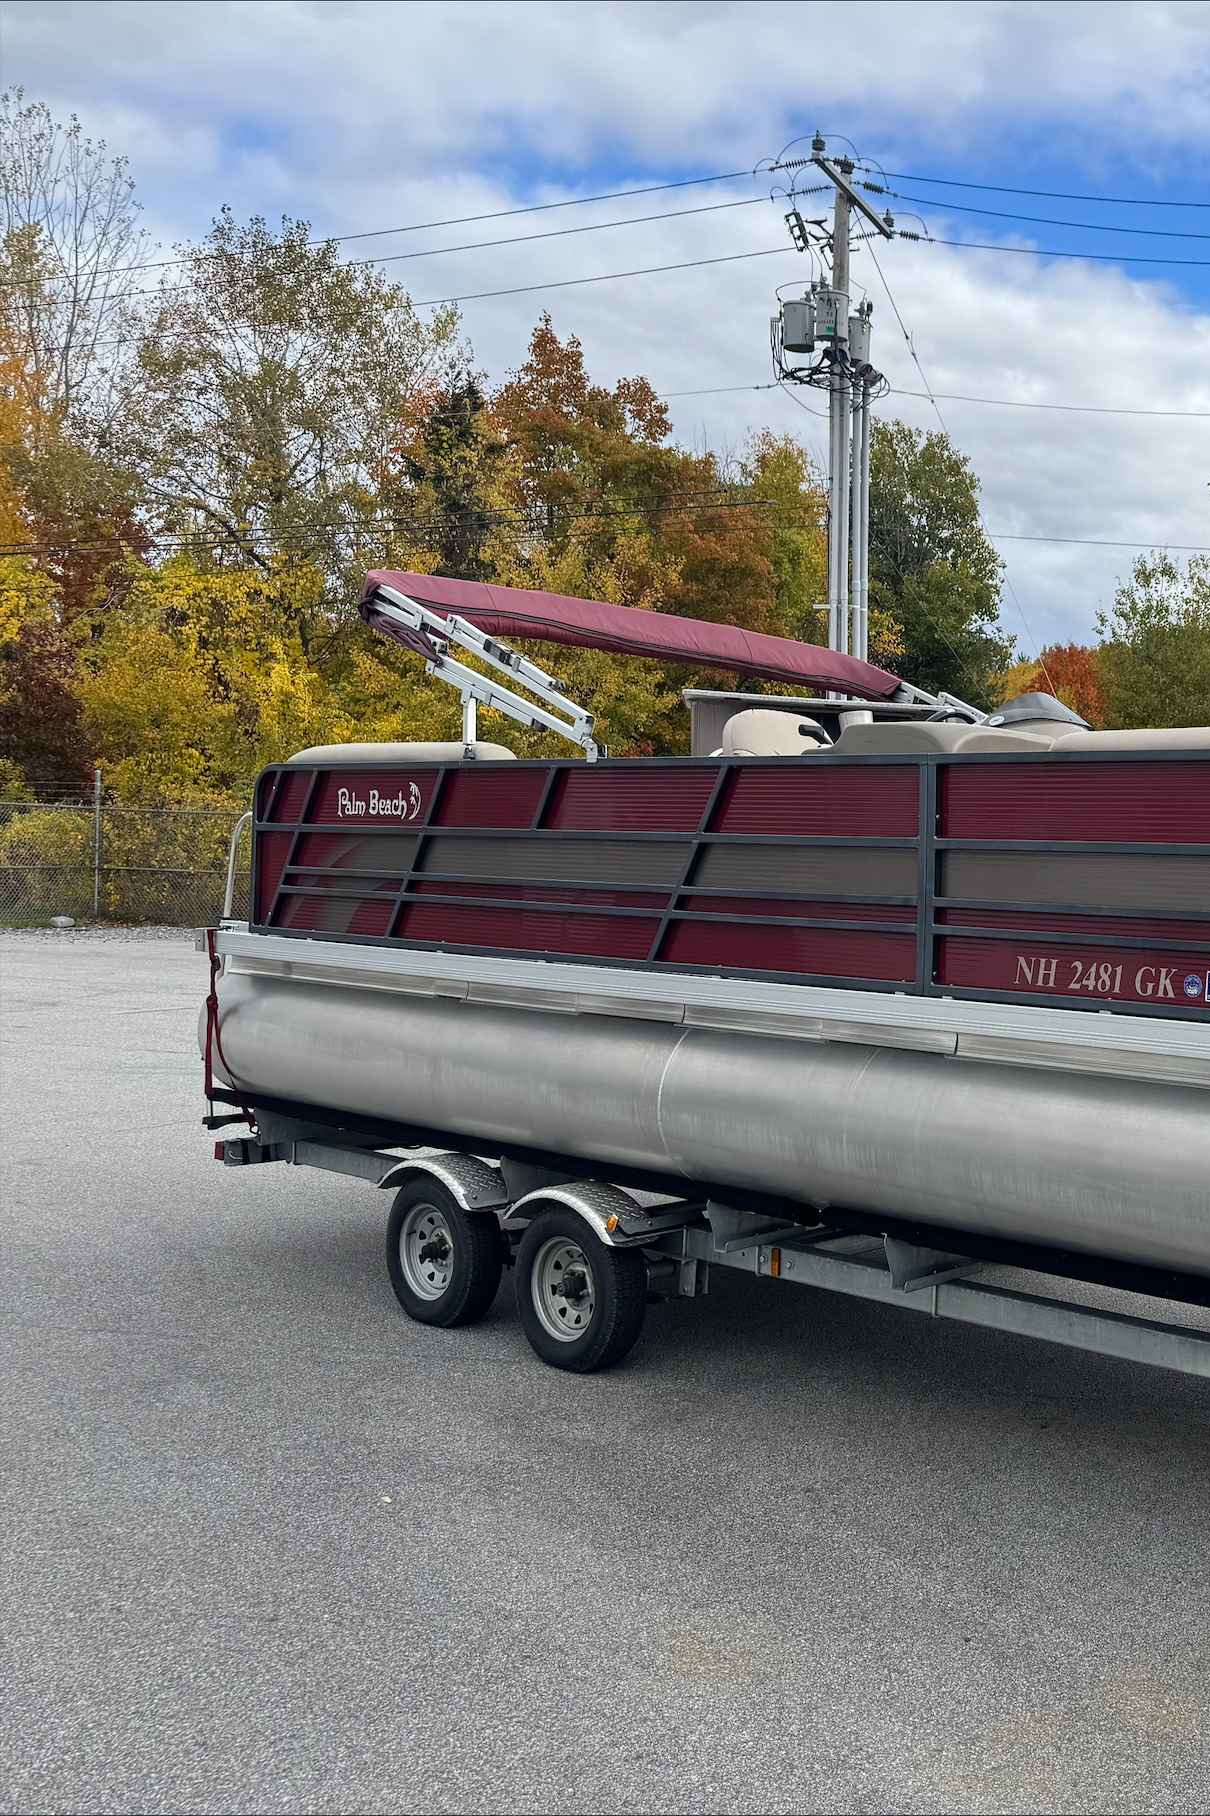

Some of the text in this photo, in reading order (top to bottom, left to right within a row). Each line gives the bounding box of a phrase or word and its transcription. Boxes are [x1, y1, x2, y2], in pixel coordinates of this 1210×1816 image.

[337, 787, 408, 819] Palm Beach
[1013, 956, 1178, 998] NH 2481 GK
